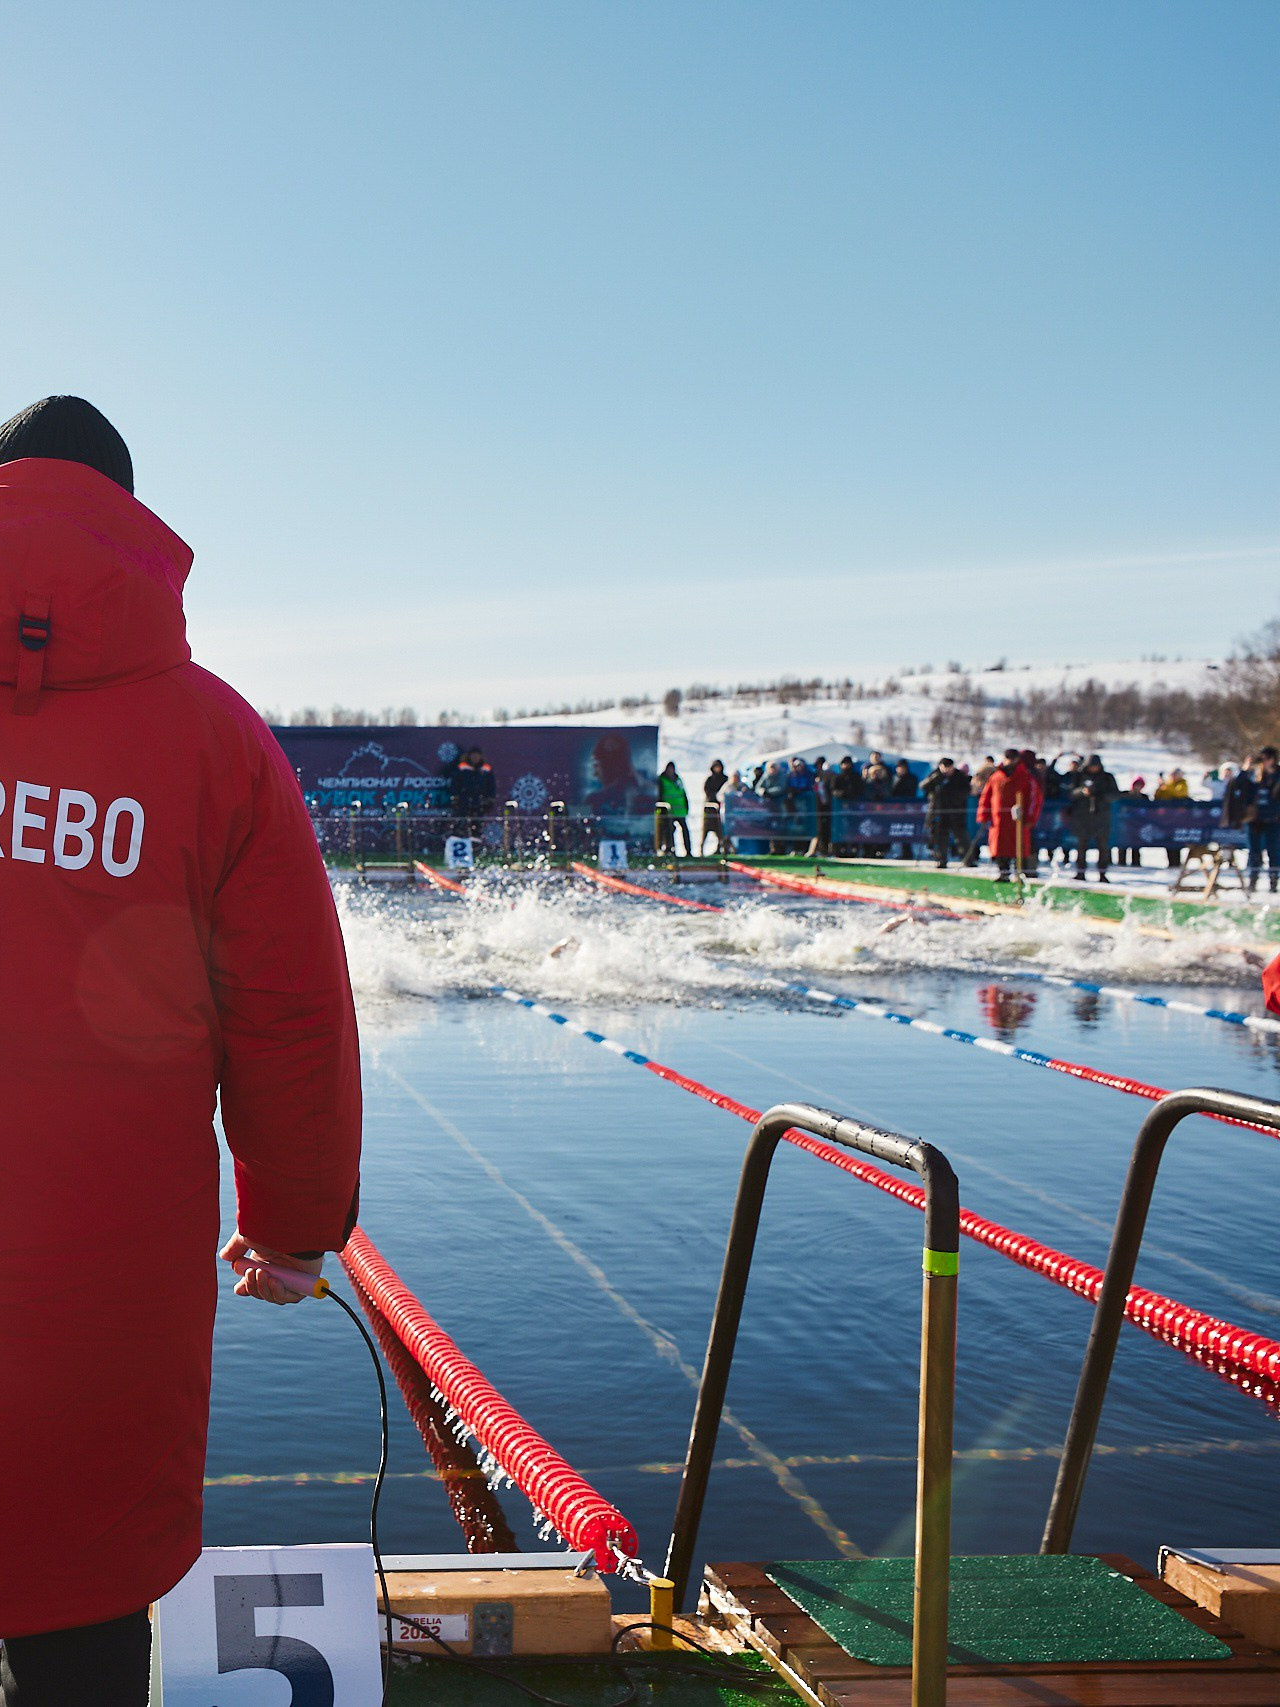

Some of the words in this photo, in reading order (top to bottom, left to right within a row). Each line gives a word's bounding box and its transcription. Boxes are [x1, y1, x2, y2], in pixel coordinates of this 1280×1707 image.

[317, 776, 400, 789] ЧЕМПИОНАТ
[403, 777, 452, 788] РОССИ
[452, 841, 467, 858] 2
[214, 1563, 335, 1707] 5
[400, 1625, 441, 1640] 2022
